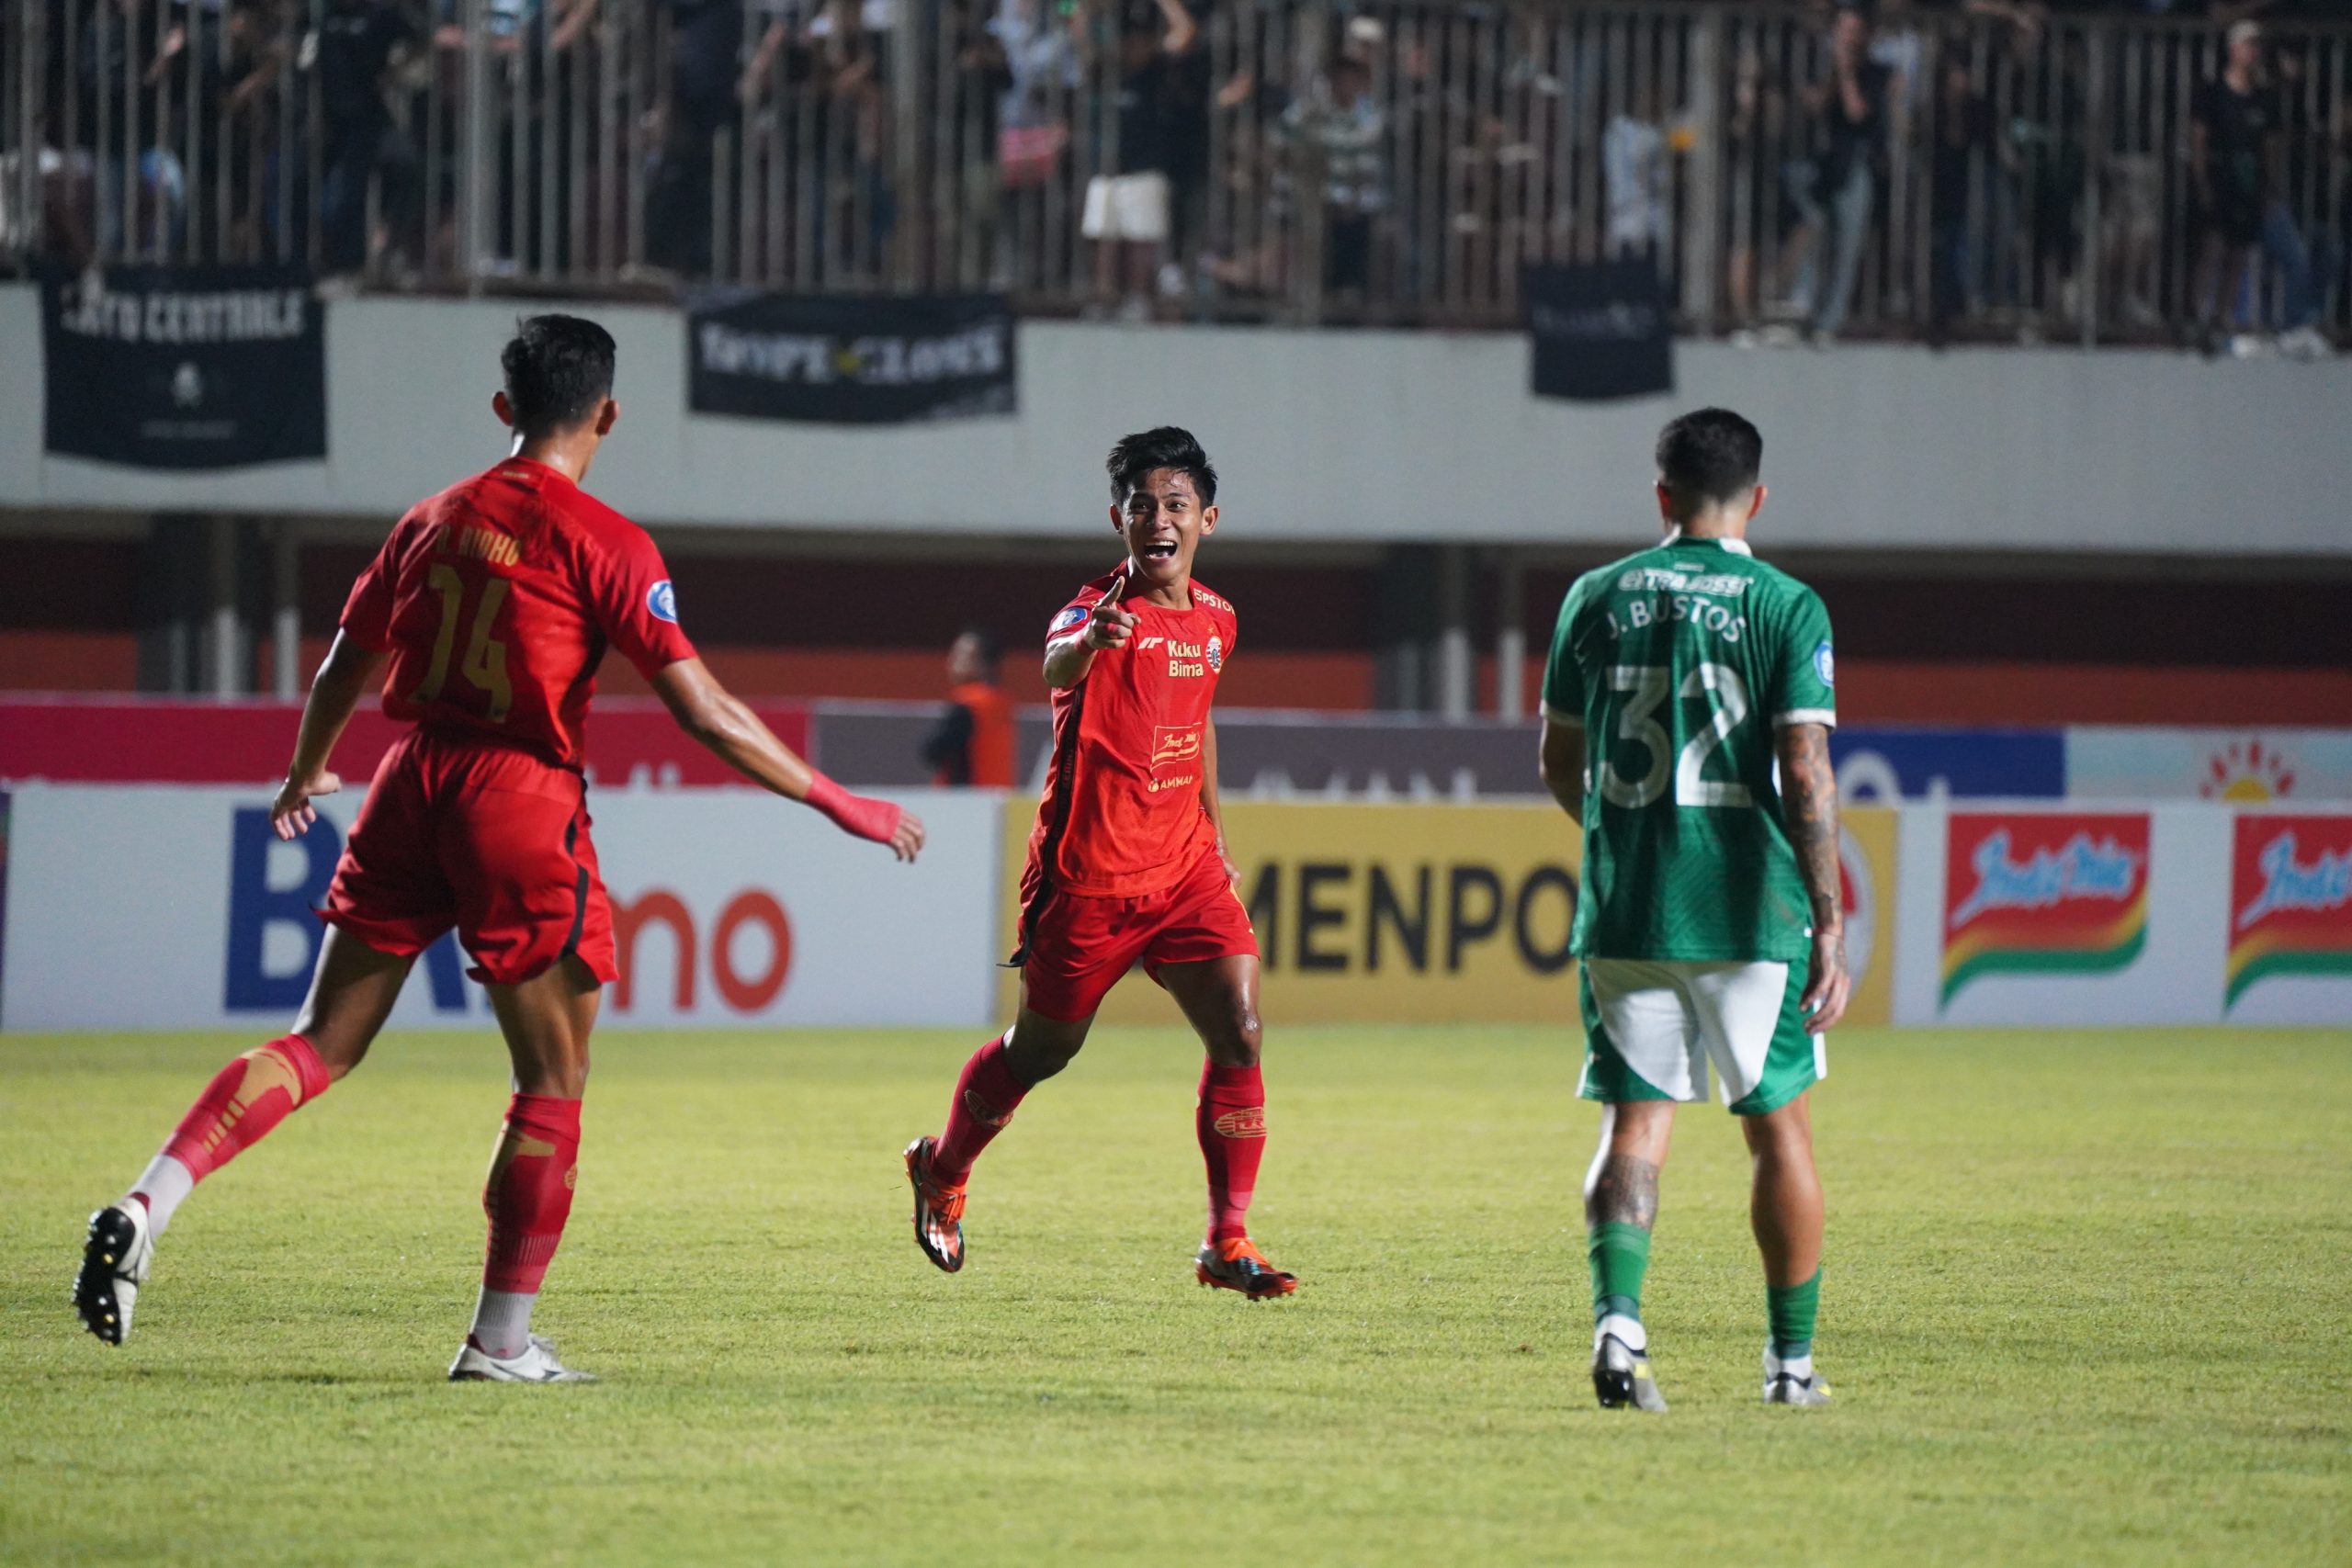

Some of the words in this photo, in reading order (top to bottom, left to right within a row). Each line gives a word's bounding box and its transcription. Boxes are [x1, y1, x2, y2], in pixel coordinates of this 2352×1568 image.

[1607, 611, 1628, 640] J.
[1630, 593, 1747, 642] BUSTOS
[408, 562, 513, 723] 14
[1167, 640, 1202, 658] Kuku
[1169, 660, 1204, 677] Bima
[1600, 661, 1754, 809] 32
